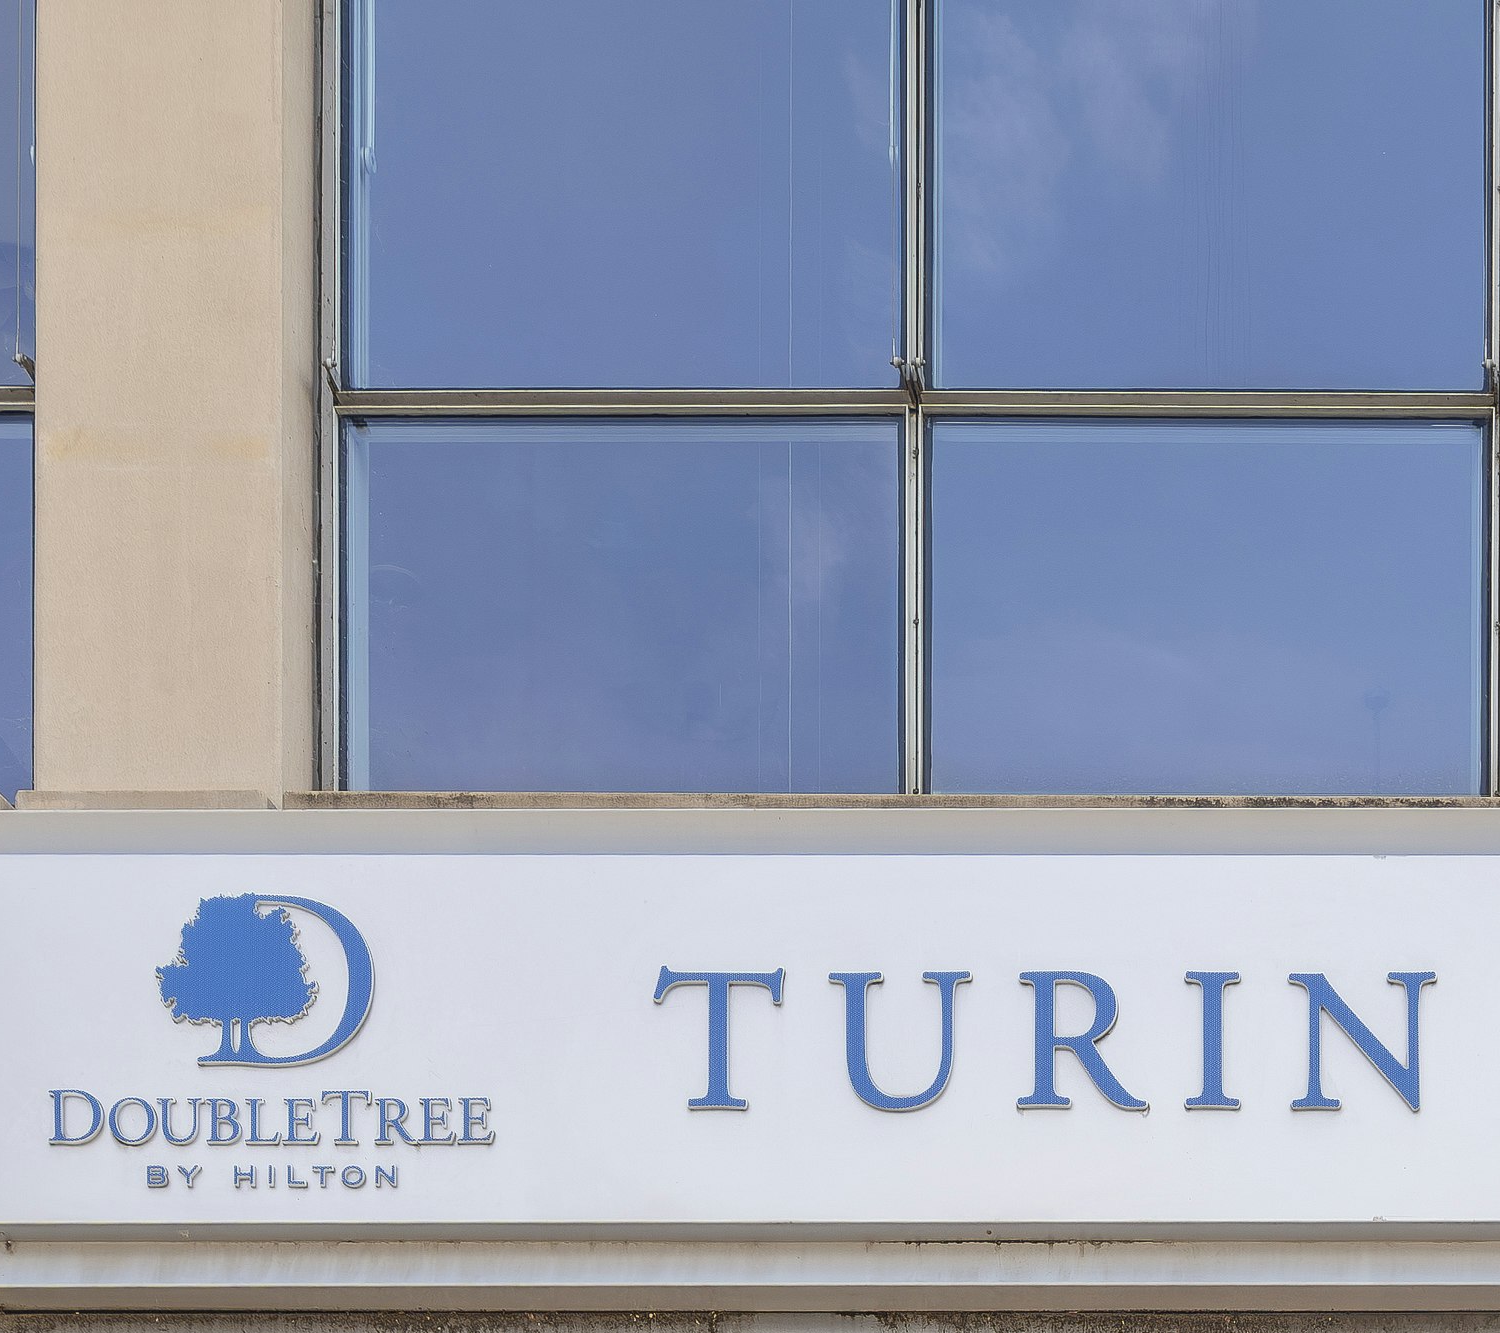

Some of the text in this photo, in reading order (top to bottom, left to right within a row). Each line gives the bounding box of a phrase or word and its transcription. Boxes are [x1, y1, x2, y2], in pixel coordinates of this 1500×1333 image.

[653, 966, 1438, 1116] TURIN
[146, 1164, 398, 1190] BY HILTON
